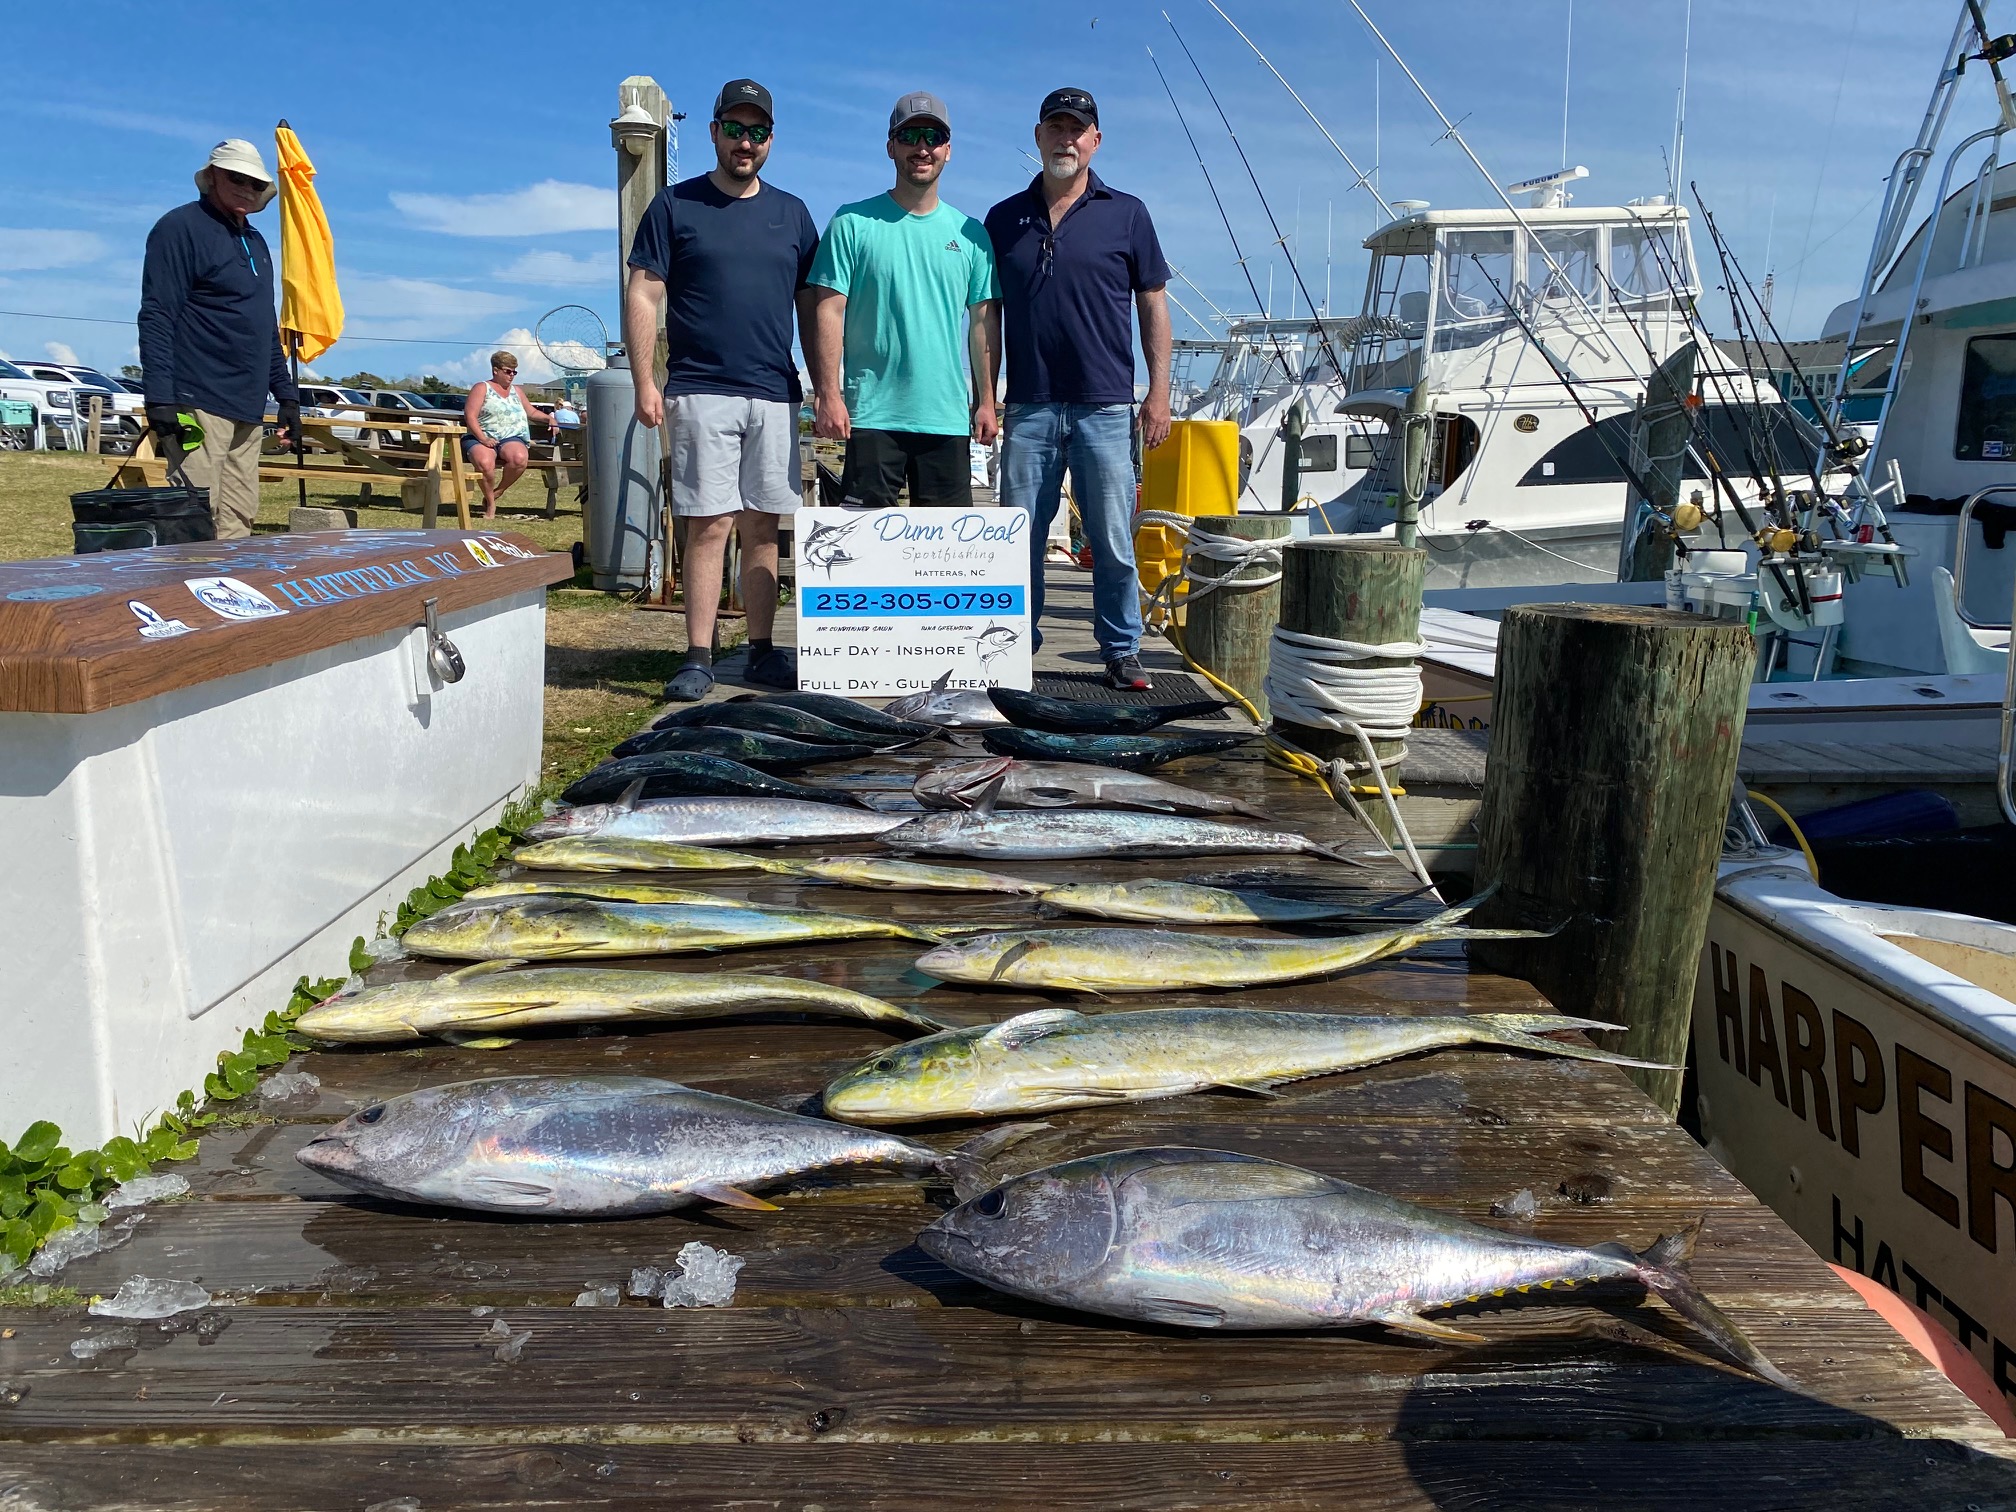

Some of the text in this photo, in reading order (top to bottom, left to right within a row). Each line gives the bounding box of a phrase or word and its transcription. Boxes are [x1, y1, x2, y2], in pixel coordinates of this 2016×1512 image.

[1522, 173, 1559, 187] FURUNO
[873, 513, 1026, 544] Dunn Deal
[902, 543, 995, 563] Sportfishing
[272, 560, 430, 607] HATTERAS
[425, 551, 463, 575] NC
[914, 569, 986, 578] HATTERAS, NC
[816, 592, 1013, 611] 252-305-0799
[800, 646, 842, 656] HALF
[848, 646, 880, 656] DAY
[897, 645, 966, 656] INSHORE
[800, 679, 842, 690] FULL
[848, 679, 880, 690] DAY
[896, 678, 999, 690] GULFTREAM
